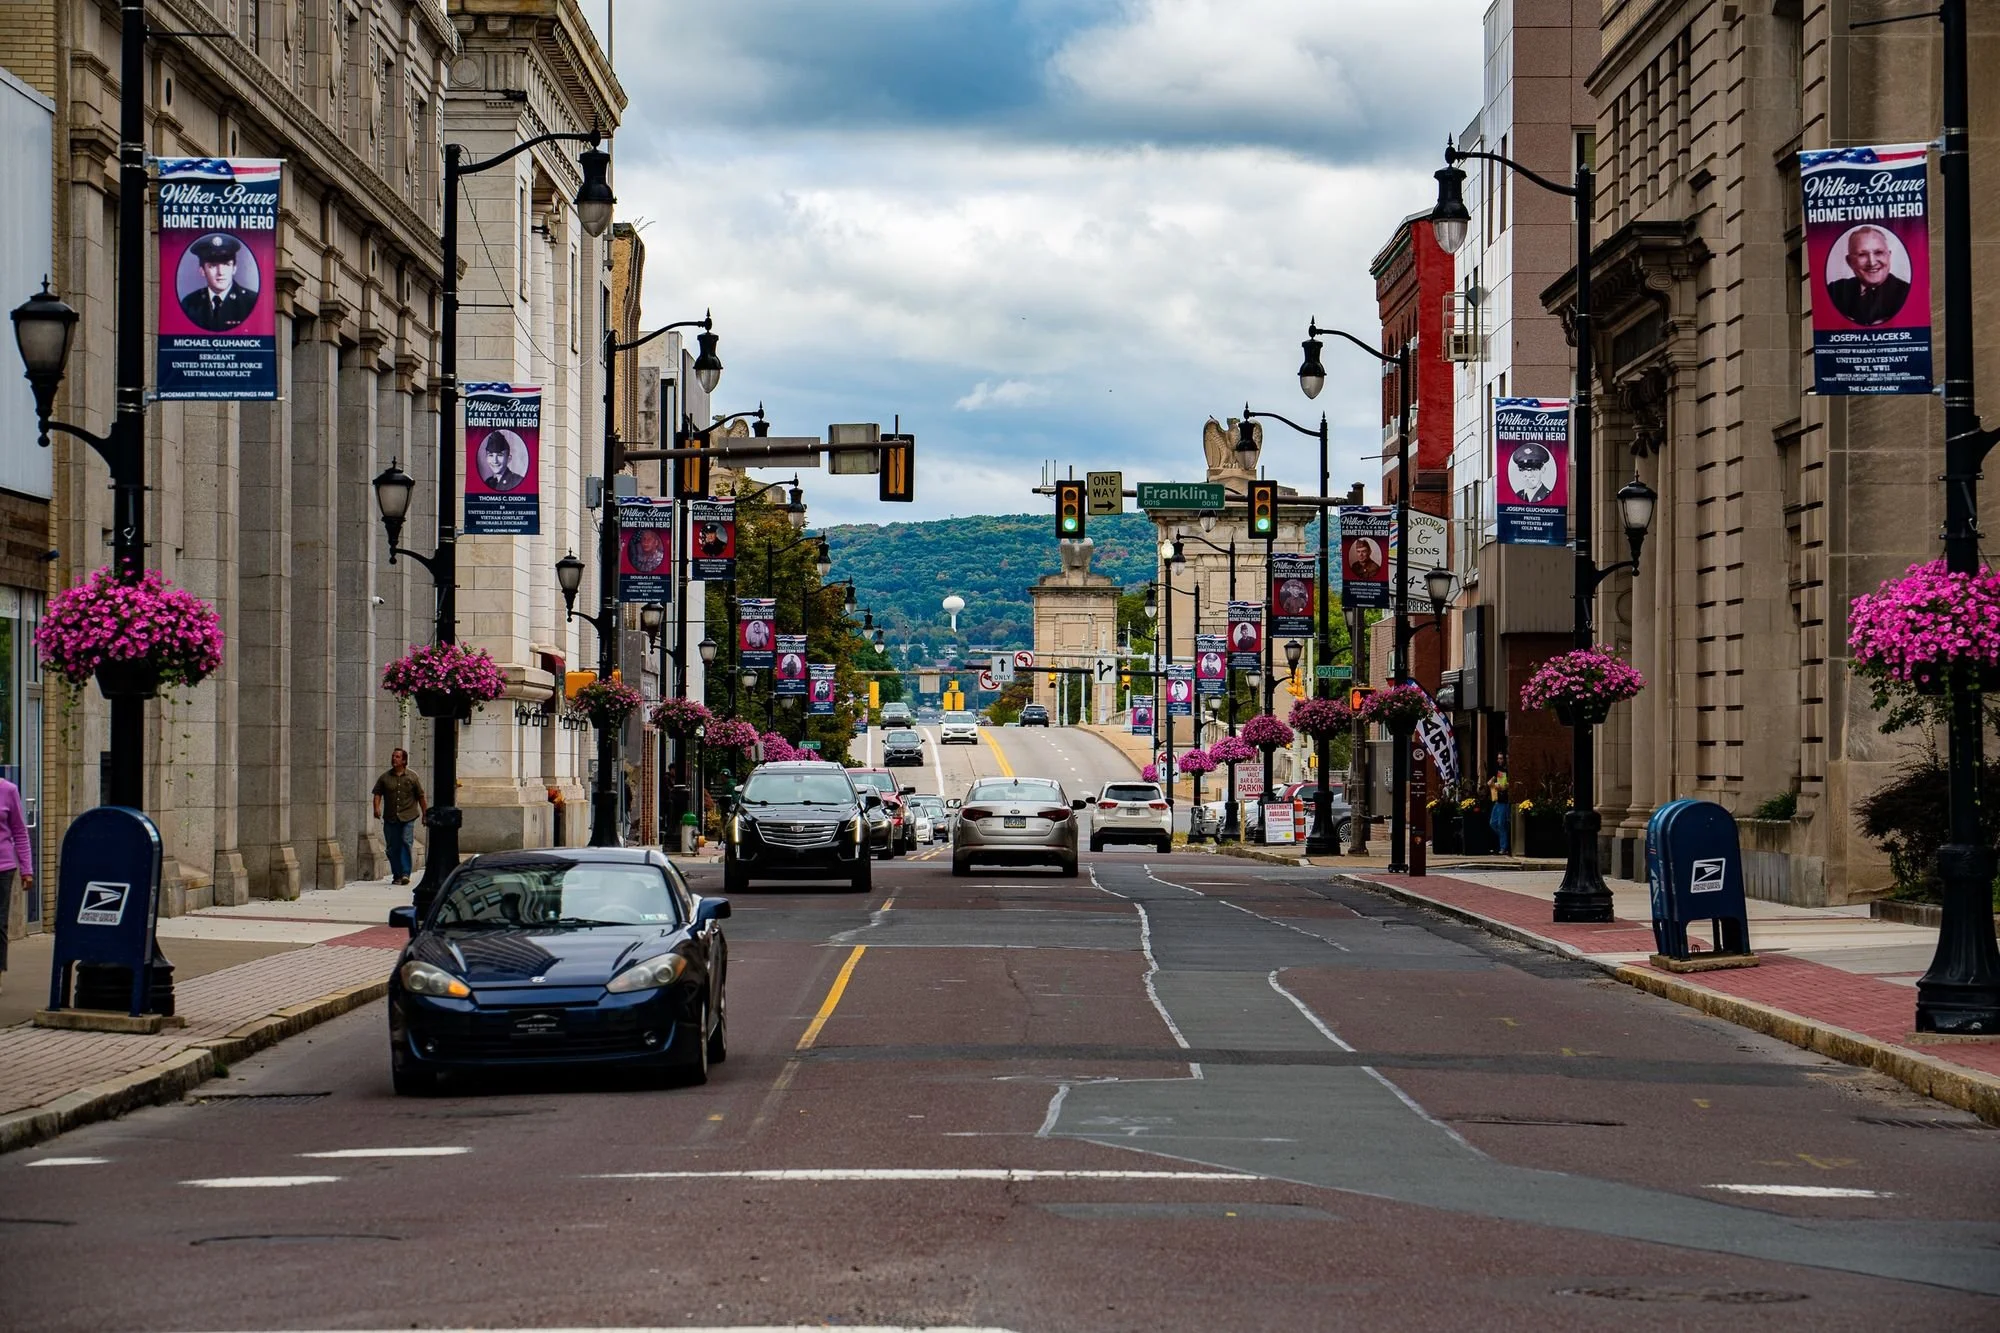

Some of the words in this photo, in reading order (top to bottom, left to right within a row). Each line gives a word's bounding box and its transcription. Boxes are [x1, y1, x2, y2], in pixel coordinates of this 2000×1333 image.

[1804, 171, 1926, 198] Wilkes-Barre
[160, 184, 277, 204] Wilkes-Barre
[1808, 193, 1922, 208] PENNSYLVANIA
[163, 206, 274, 214] PENNSYLVANIA
[1808, 206, 1884, 223] HOMETOWN
[1889, 202, 1923, 218] HERO
[163, 214, 236, 228] HOMETOWN
[240, 216, 274, 229] HERO
[1872, 333, 1898, 341] LACEK
[1900, 332, 1912, 340] SR.
[174, 339, 211, 347] MICHAEL
[212, 339, 260, 347] GLUHANICK
[466, 398, 539, 412] Wilkes-Barre
[468, 418, 514, 427] HOMETOWN
[517, 419, 538, 427] HERO
[1497, 412, 1567, 426] Wilkes-Barre
[1499, 431, 1543, 440] HOMETOWN
[1545, 432, 1566, 441] HERO
[1094, 476, 1116, 486] ONE
[1093, 488, 1116, 498] WAY
[1144, 486, 1208, 499] Franklin
[621, 508, 671, 517] Wilkes-Barre
[693, 504, 734, 512] Wilkes-Barre
[1341, 516, 1390, 525] Wilkes-Barre
[1417, 529, 1432, 544] &
[1238, 784, 1264, 792] PARKIN
